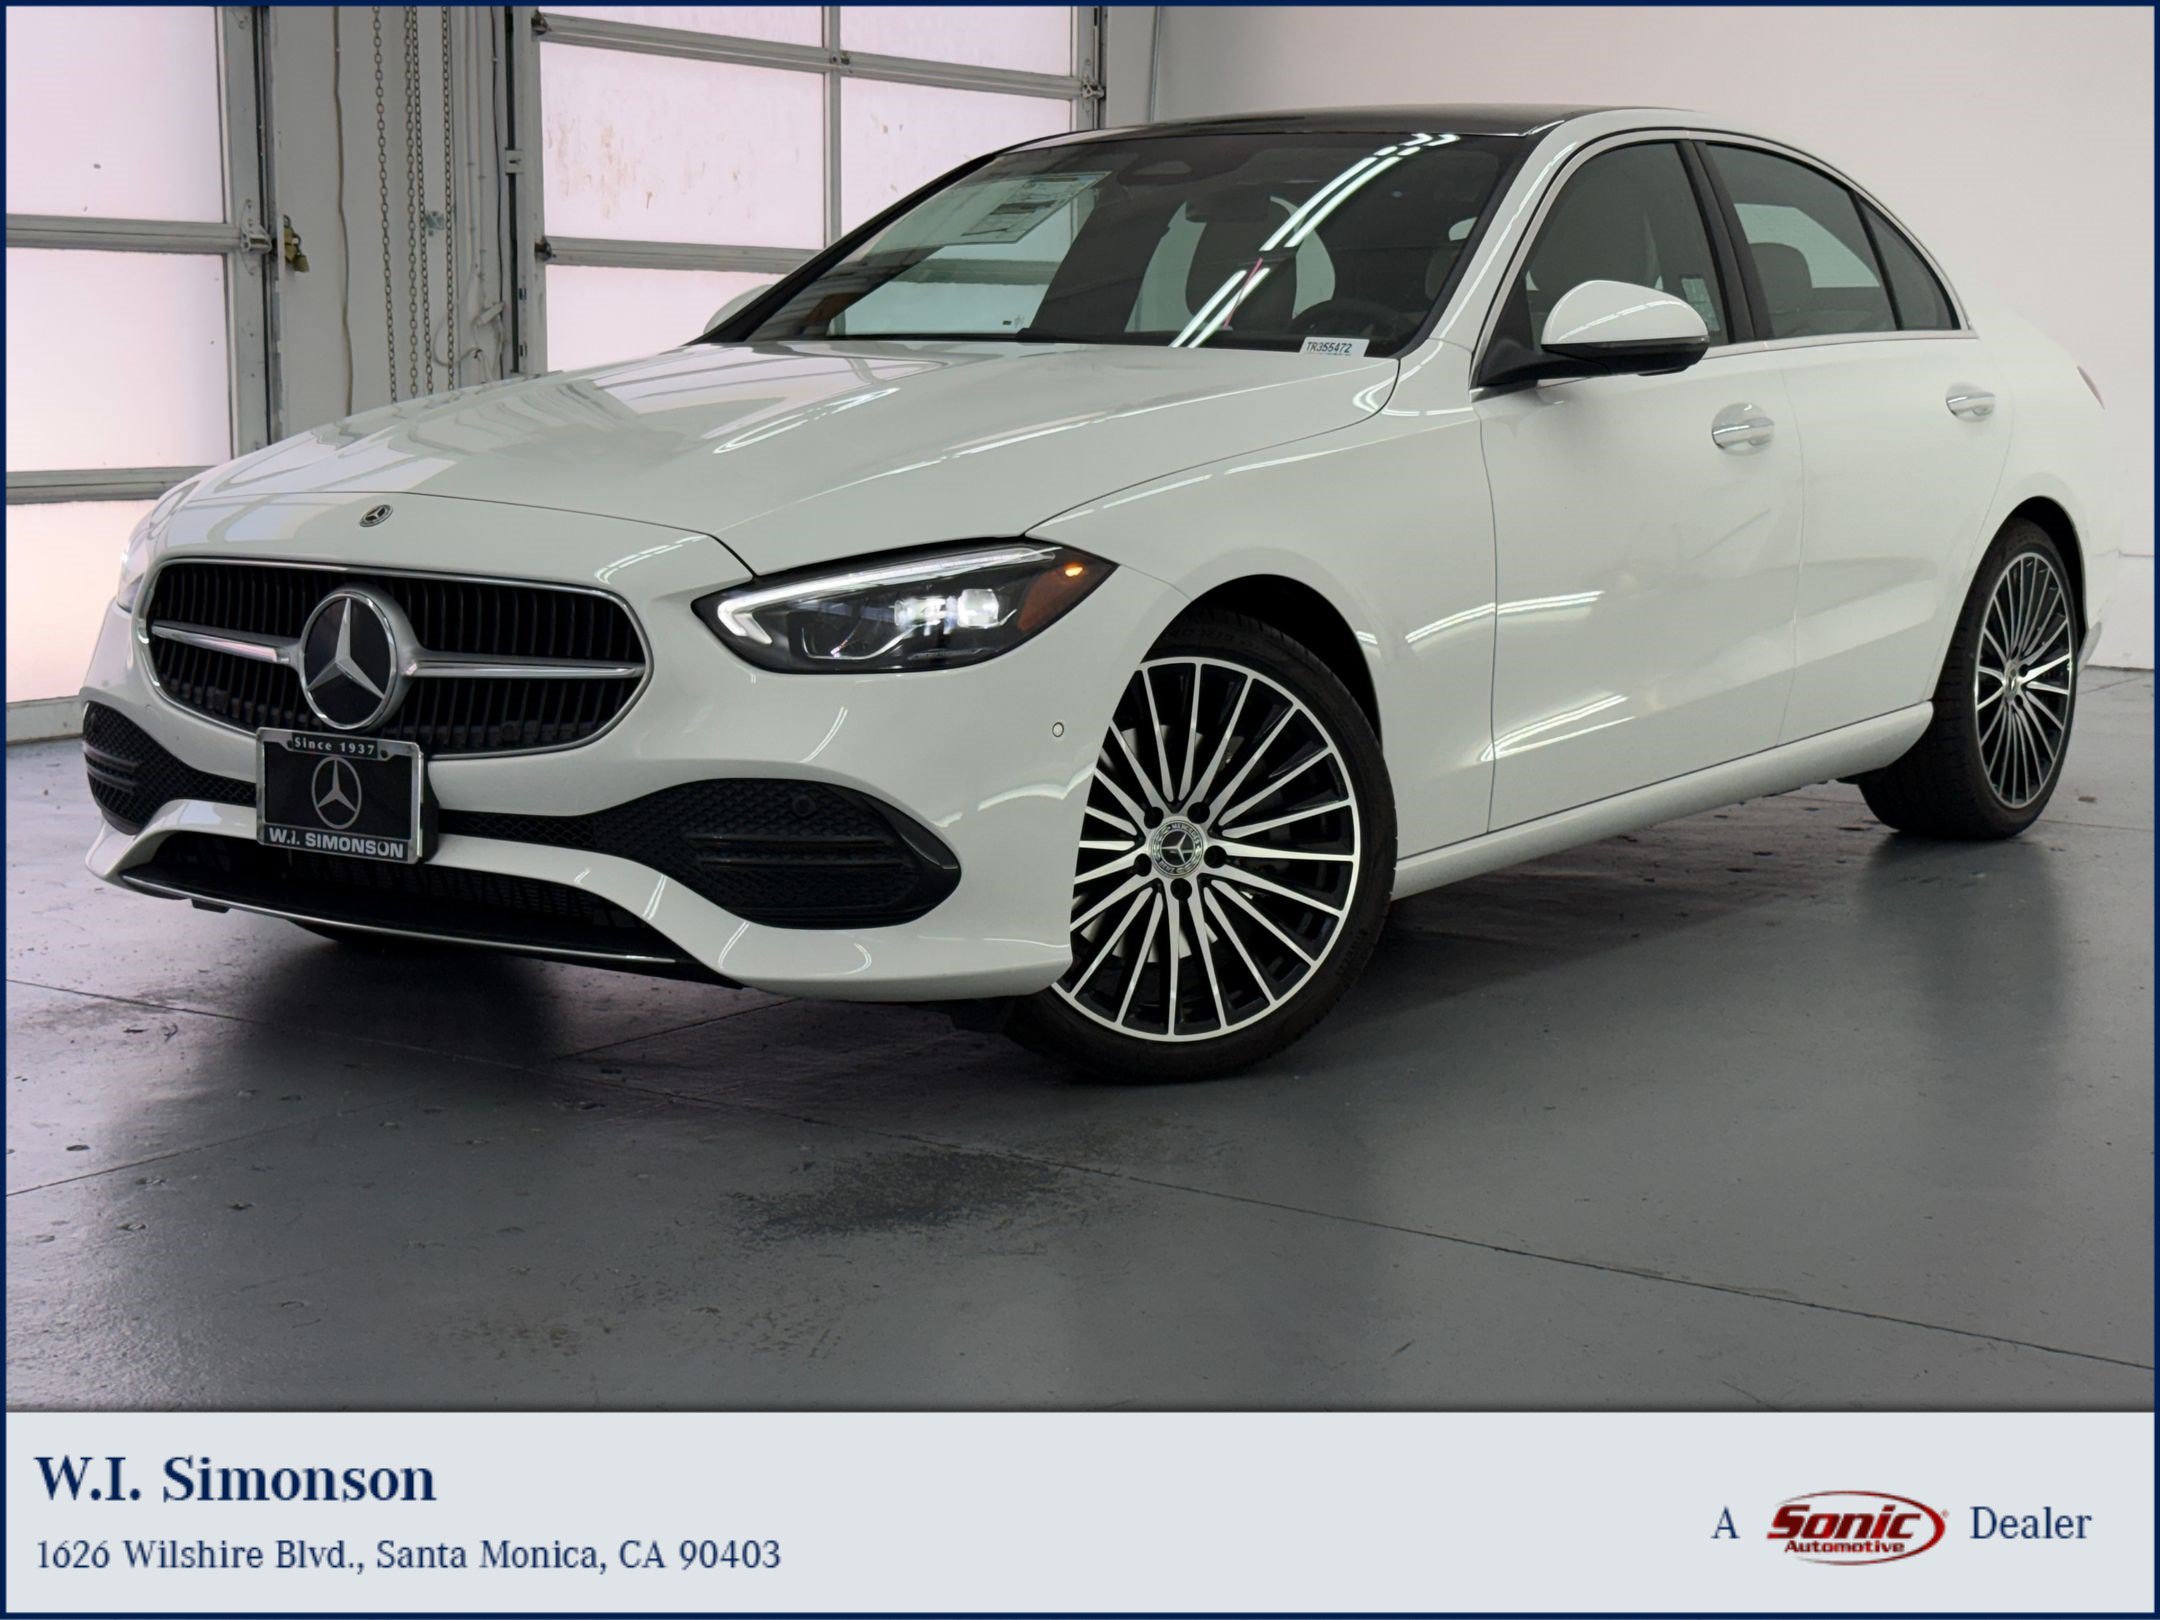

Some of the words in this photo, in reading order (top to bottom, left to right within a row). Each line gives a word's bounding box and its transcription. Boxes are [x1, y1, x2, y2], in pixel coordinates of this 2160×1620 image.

[1306, 341, 1352, 353] TR355472
[294, 736, 332, 750] Since
[340, 741, 375, 755] 1937
[305, 832, 404, 858] SIMONSON
